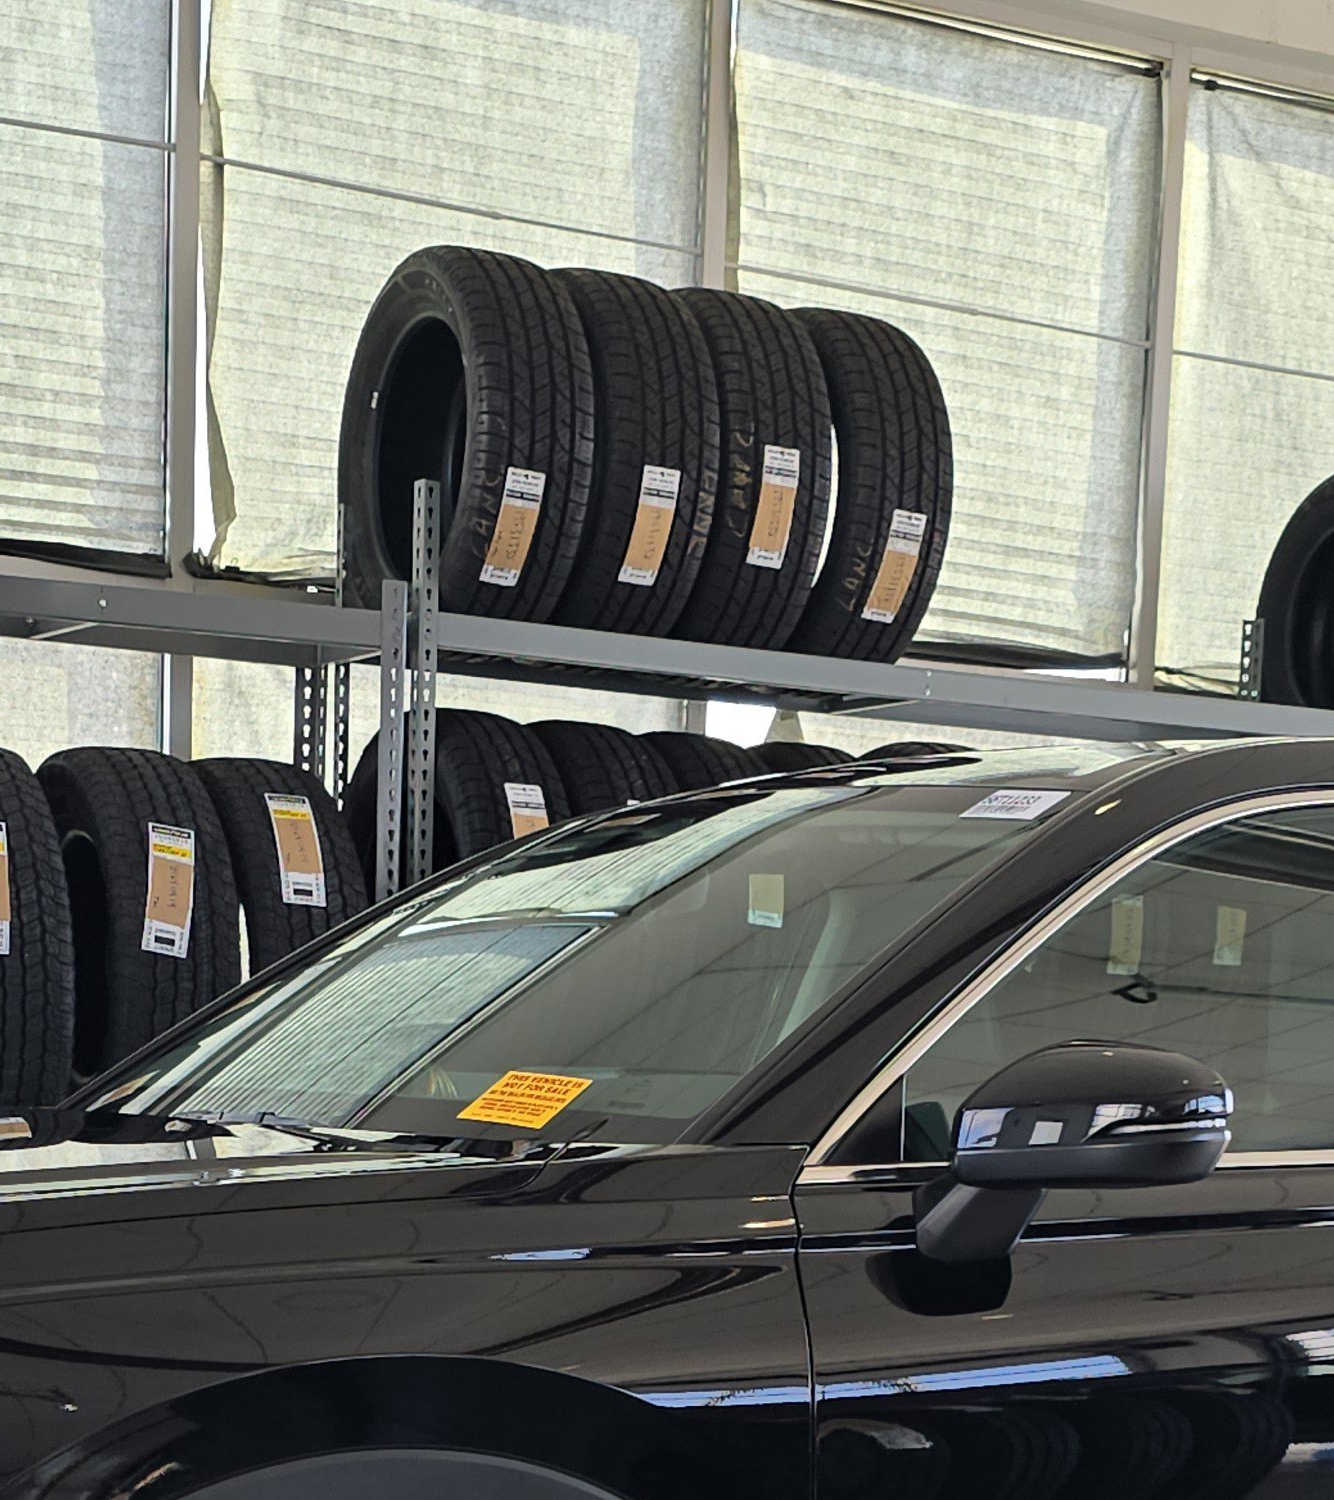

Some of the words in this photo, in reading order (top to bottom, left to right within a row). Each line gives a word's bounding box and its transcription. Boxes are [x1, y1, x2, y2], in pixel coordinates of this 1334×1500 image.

[502, 1082, 524, 1090] NOT
[524, 1084, 546, 1093] FOR
[545, 1086, 571, 1096] SALE
